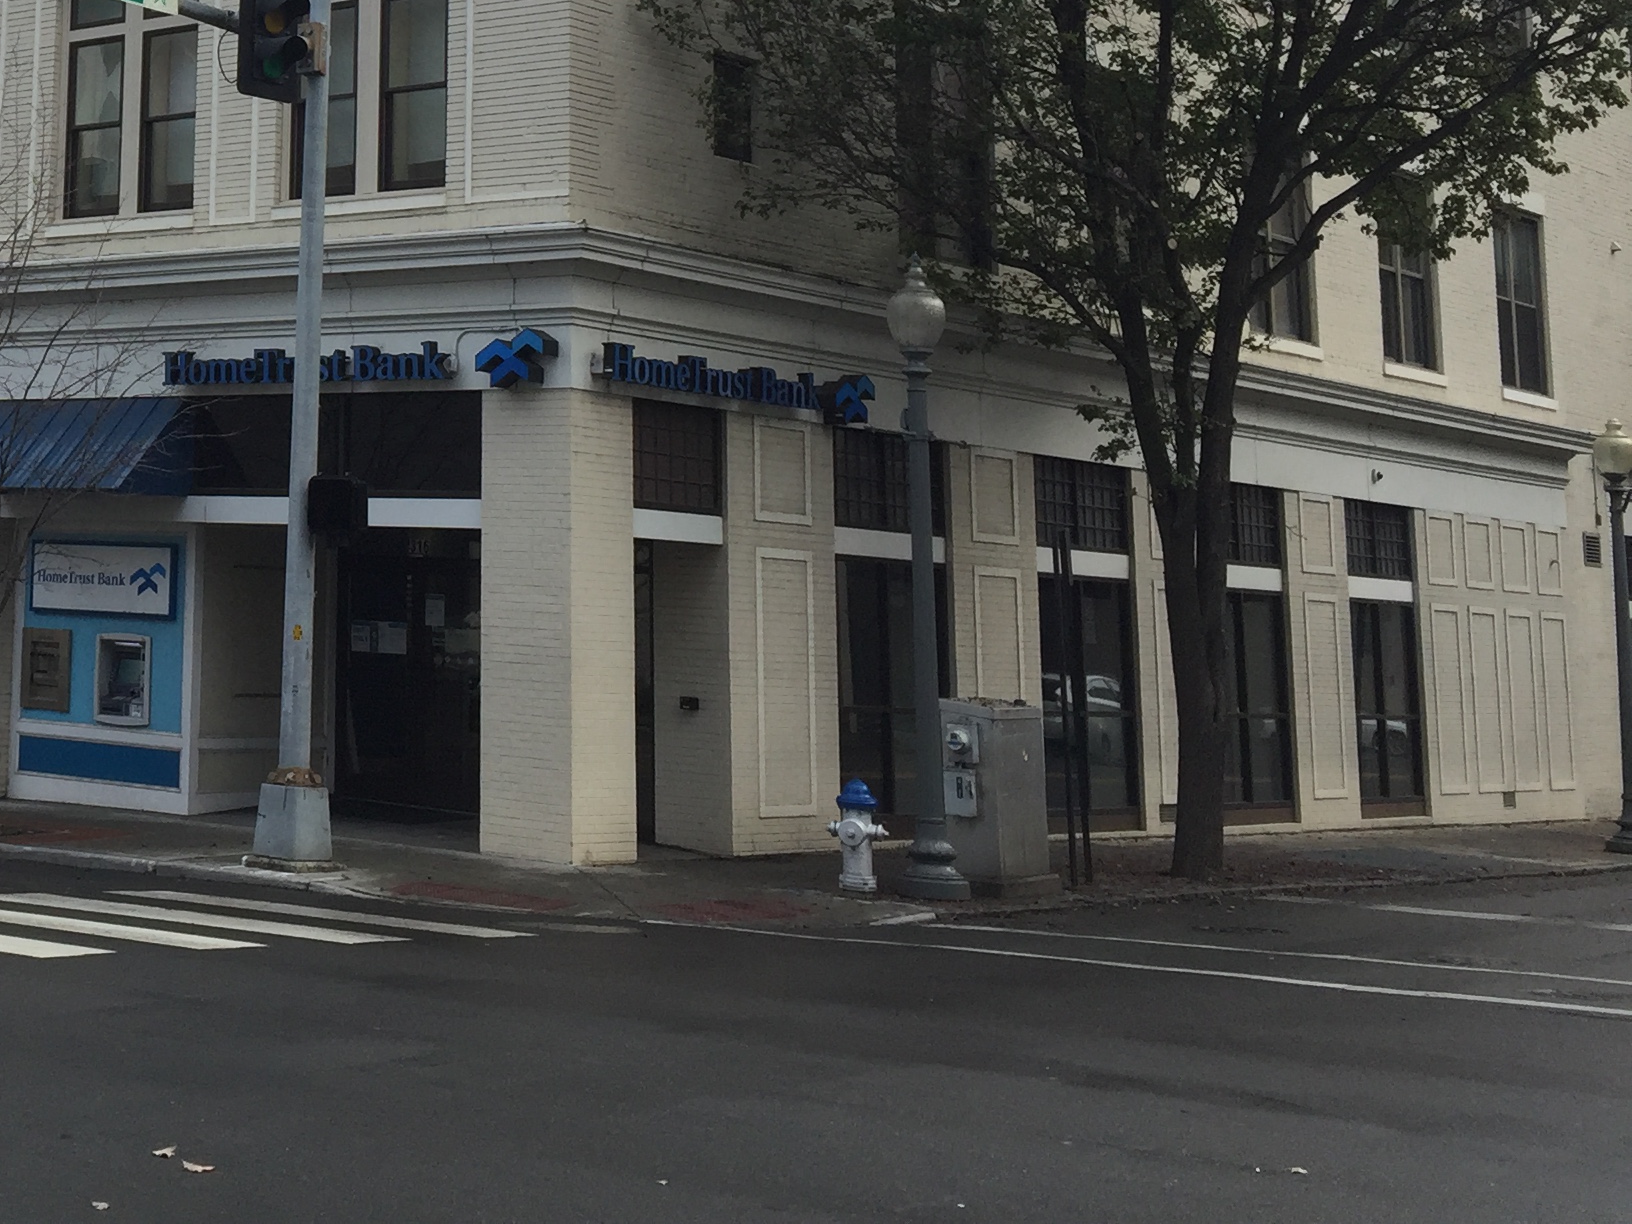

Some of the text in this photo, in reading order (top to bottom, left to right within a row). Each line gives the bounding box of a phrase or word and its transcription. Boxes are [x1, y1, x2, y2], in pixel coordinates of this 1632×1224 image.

[162, 340, 452, 386] HomeTrst Bank
[603, 342, 821, 410] HomeTrust Bank
[37, 569, 126, 586] HomeTrust Bank
